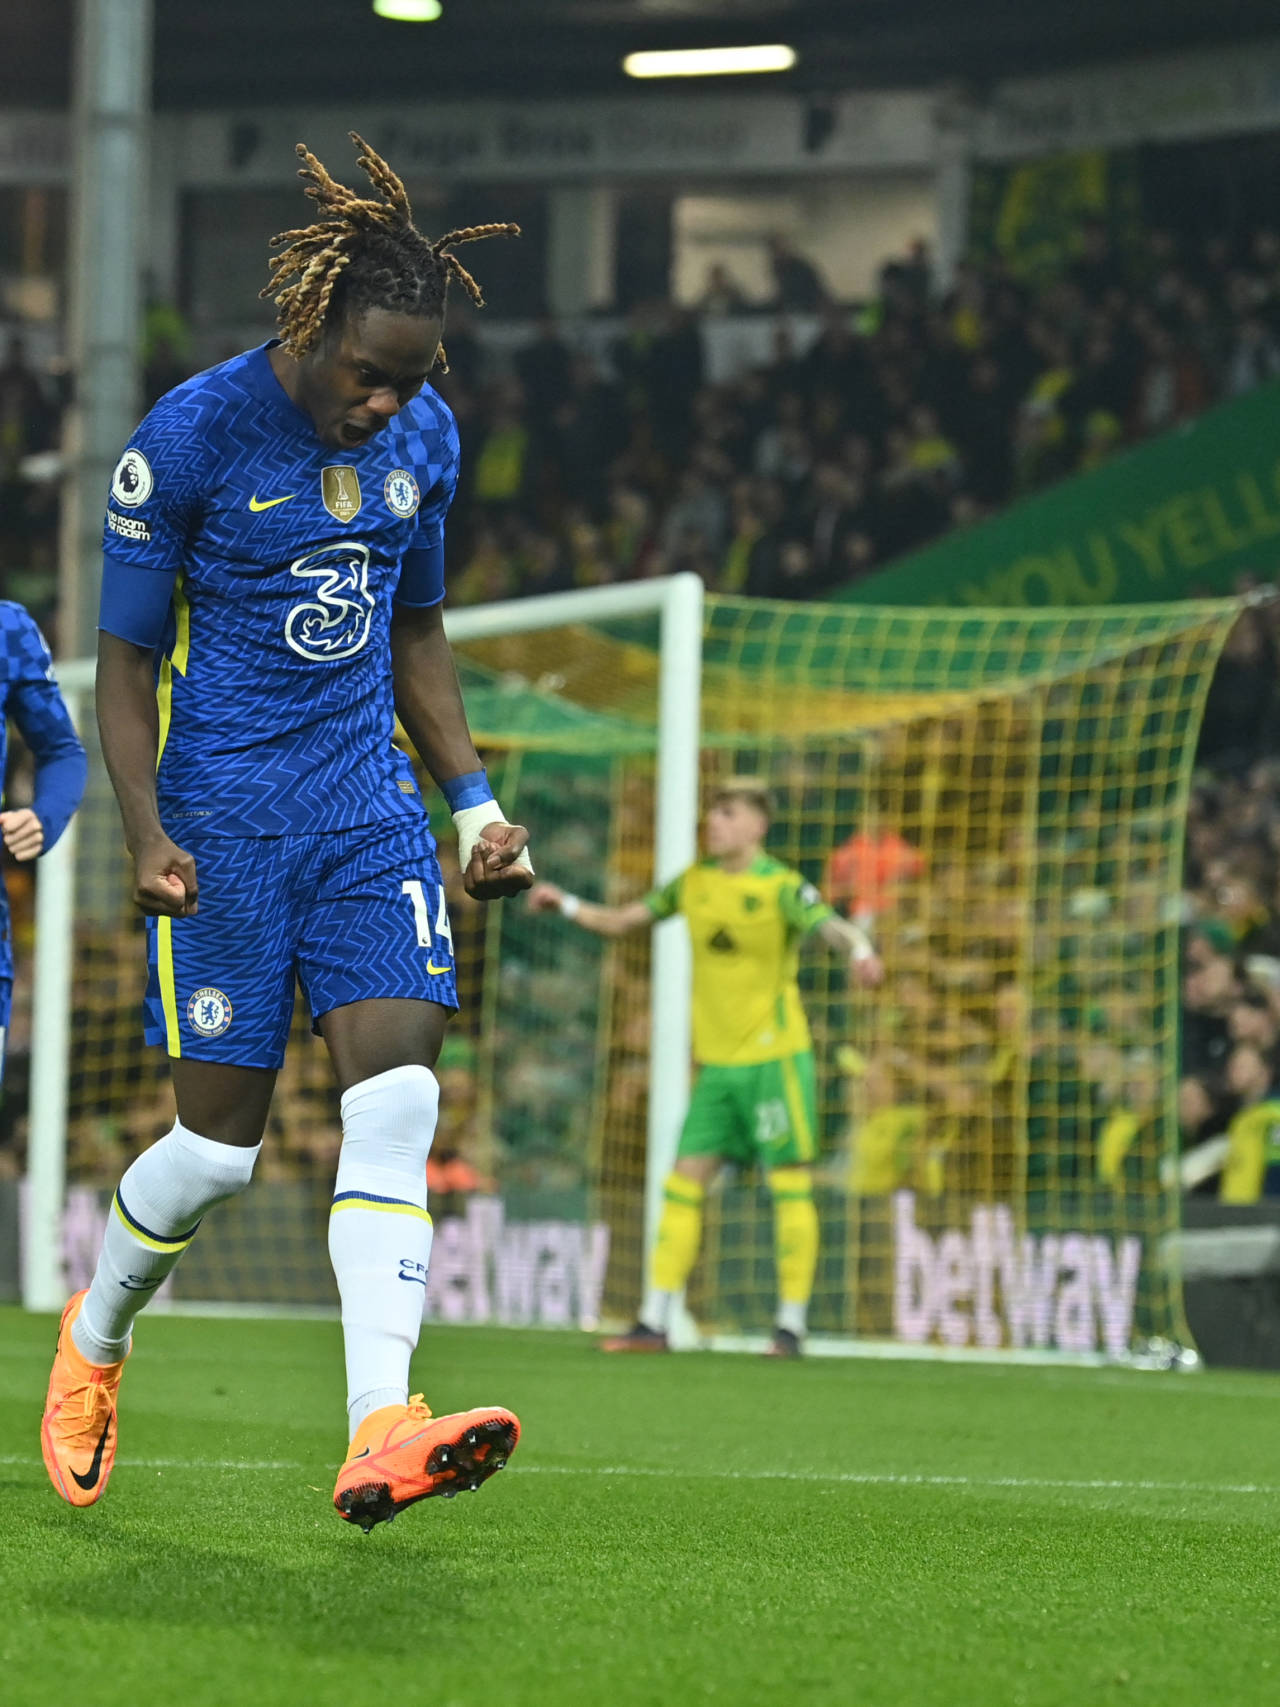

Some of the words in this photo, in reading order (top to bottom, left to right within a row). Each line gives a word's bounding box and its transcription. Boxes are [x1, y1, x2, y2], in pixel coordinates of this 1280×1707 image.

[116, 525, 152, 542] racism
[117, 515, 146, 532] room
[285, 542, 376, 661] 3
[402, 880, 455, 957] 14
[400, 1258, 428, 1275] CF
[425, 1197, 610, 1330] etway
[894, 1189, 1142, 1360] betway
